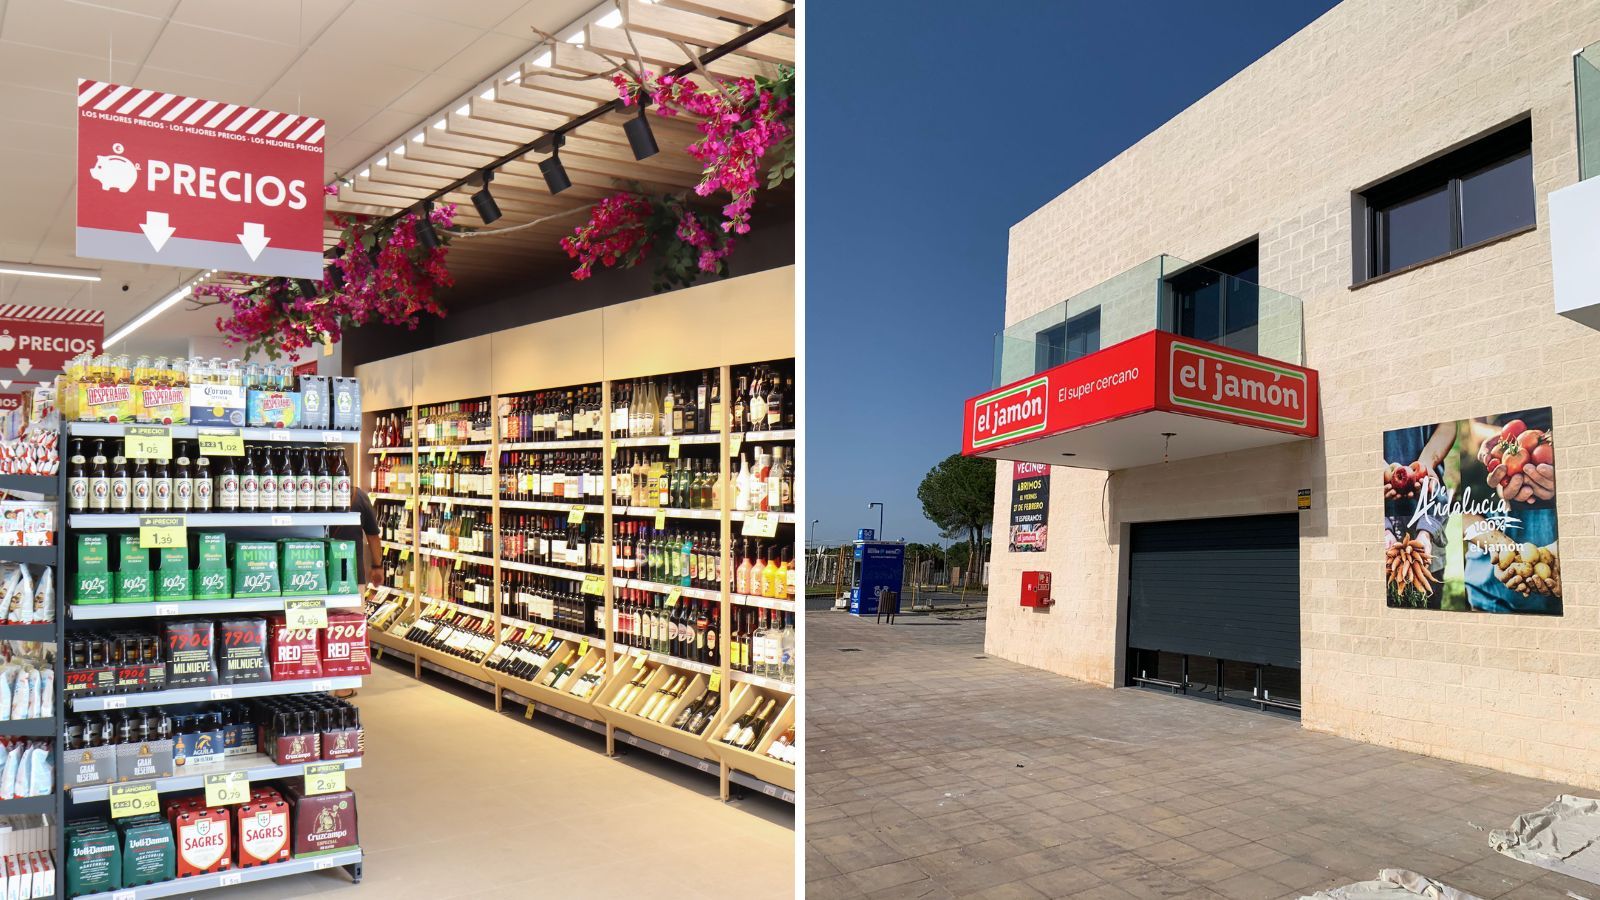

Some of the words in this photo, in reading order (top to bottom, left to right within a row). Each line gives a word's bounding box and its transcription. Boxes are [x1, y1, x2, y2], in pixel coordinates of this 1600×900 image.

[81, 109, 98, 119] LOS
[98, 112, 133, 124] MEJORES
[133, 117, 165, 129] PRECIOS
[169, 124, 184, 132] LOS
[185, 125, 217, 137] MEJORES
[218, 131, 247, 142] PRECIOS
[251, 137, 265, 145] LOS
[265, 139, 295, 149] MEJORES
[296, 144, 323, 154] PRECIOS
[147, 159, 308, 210] PRECIOS
[19, 335, 96, 353] PRECIOS
[204, 386, 233, 396] Corona
[1058, 387, 1067, 403] El
[1067, 381, 1095, 401] super
[1096, 366, 1139, 391] cercano
[1180, 358, 1207, 391] el
[1212, 362, 1299, 410] jamón
[88, 388, 130, 404] DESPERADOS
[143, 390, 185, 406] DESPERADOS
[978, 405, 990, 433] el
[992, 390, 1042, 434] jamón
[1017, 480, 1042, 491] ABRIMOS
[1429, 477, 1447, 501] De
[1024, 502, 1044, 511] FEBRERO
[1407, 476, 1509, 528] Andalucía
[1475, 519, 1507, 532] 100%
[152, 533, 173, 546] 1,39
[243, 550, 272, 561] MINI
[291, 549, 319, 560] MINI
[1470, 541, 1483, 553] el
[1484, 541, 1525, 555] jamón
[80, 577, 106, 594] 1925
[122, 576, 148, 593] 1925
[163, 574, 187, 592] 1925
[201, 573, 226, 591] 1925
[243, 572, 273, 593] 1925
[291, 571, 320, 591] 1925
[278, 628, 316, 643] 1906
[326, 625, 367, 640] 1906
[169, 633, 211, 650] 1906
[278, 645, 301, 662] RED
[327, 642, 350, 658] RED
[173, 661, 211, 675] MILNUEVE
[227, 658, 264, 671] MILNUEVE
[66, 672, 95, 685] 1906
[119, 668, 146, 679] 1906
[79, 764, 95, 774] GRAN
[134, 765, 156, 776] RESERVA
[137, 758, 152, 768] GRAN
[76, 772, 100, 783] RESERVA
[217, 788, 241, 800] 0,79
[246, 825, 284, 842] SAGRES
[308, 831, 347, 842] Cruzcampo
[185, 833, 224, 851] SAGRES
